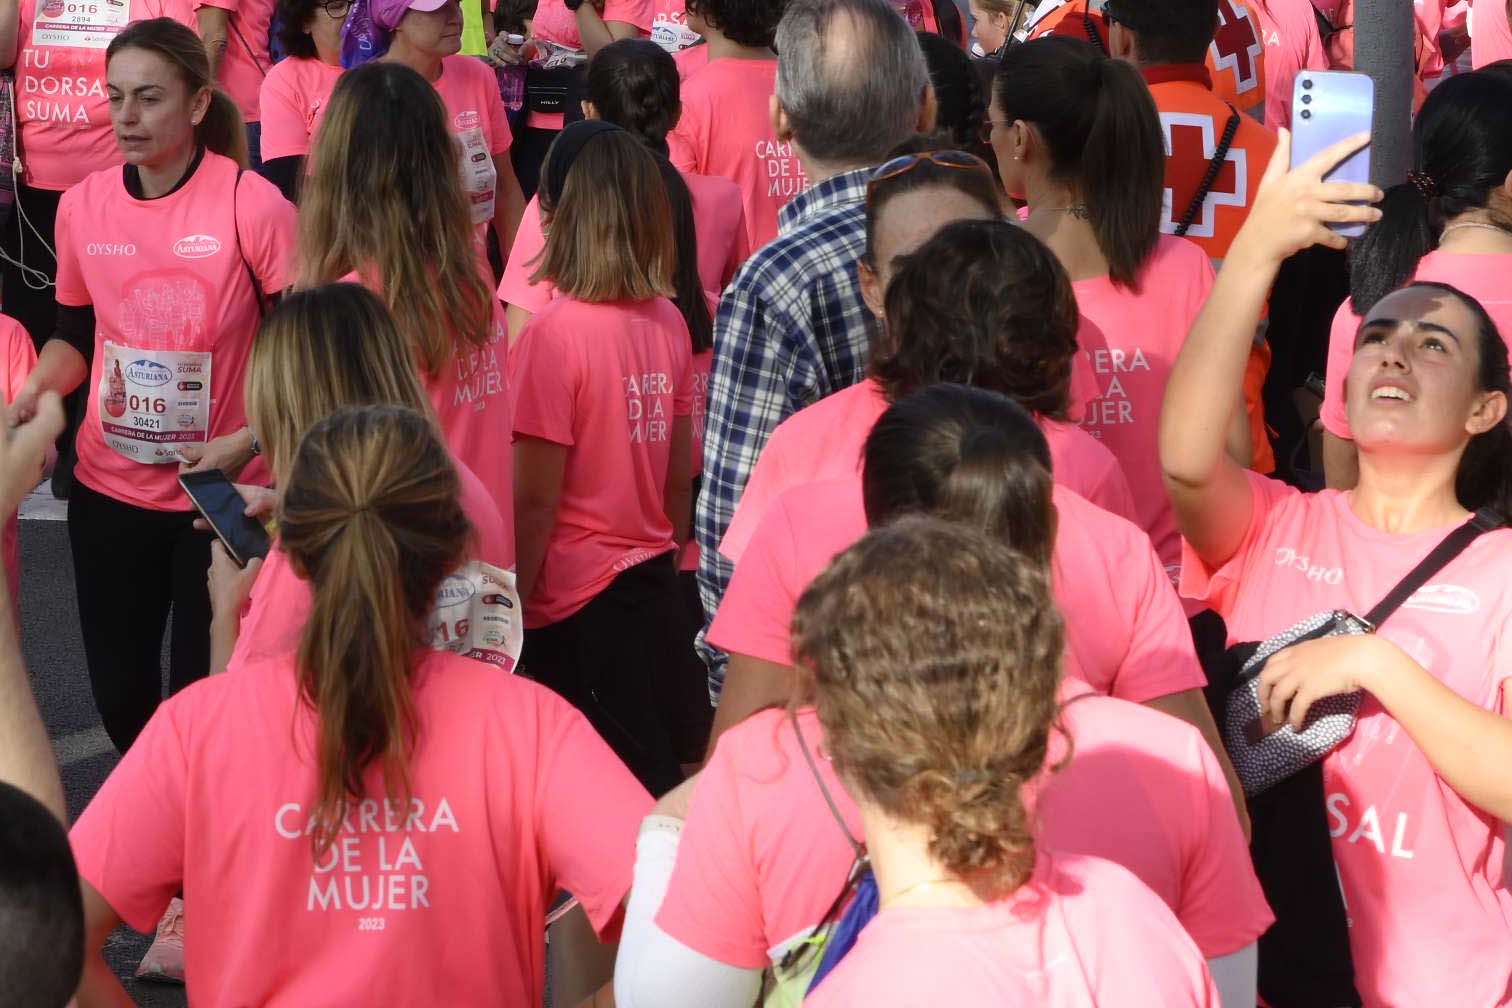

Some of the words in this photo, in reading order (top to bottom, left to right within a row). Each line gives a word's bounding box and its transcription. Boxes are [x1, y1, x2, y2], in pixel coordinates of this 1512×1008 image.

[68, 4, 98, 14] 016
[23, 49, 50, 68] TU
[25, 75, 110, 98] DORSA
[26, 100, 89, 123] SUMA
[768, 159, 789, 178] DE
[88, 243, 136, 256] OYSHO
[178, 242, 217, 253] ASTURIANA
[128, 369, 168, 382] ASTURIANA
[177, 366, 202, 374] SUMA
[129, 395, 166, 414] 016
[133, 416, 160, 429] 30421
[111, 426, 136, 438] CARRERA
[137, 431, 144, 439] DE
[145, 432, 153, 440] LA
[154, 433, 176, 441] MUJER
[378, 839, 423, 871] LA
[306, 875, 431, 911] MUJER
[358, 917, 385, 930] 2023
